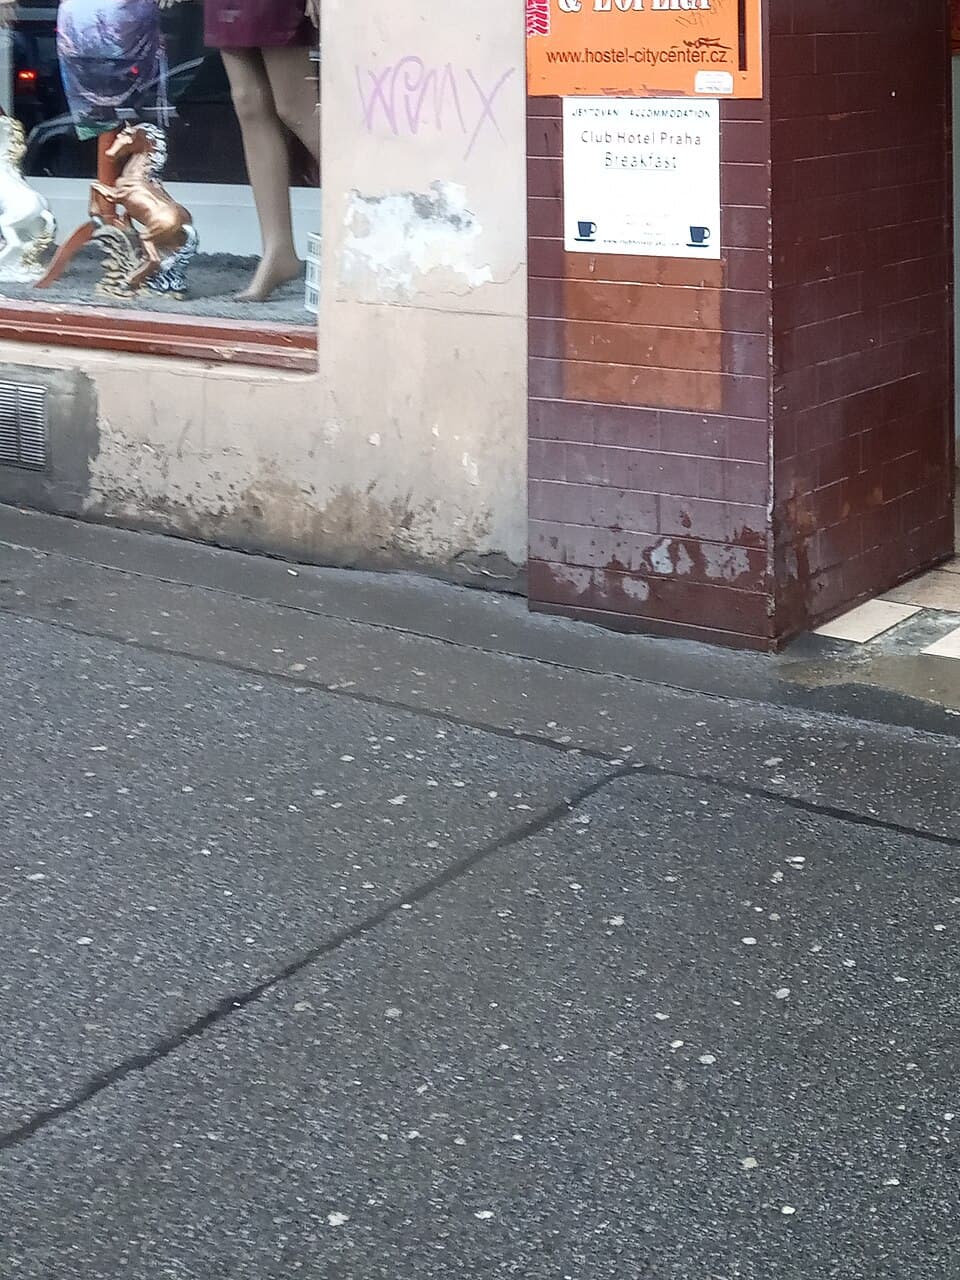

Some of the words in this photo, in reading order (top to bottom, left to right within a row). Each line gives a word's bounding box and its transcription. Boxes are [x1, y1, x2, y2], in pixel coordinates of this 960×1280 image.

[546, 47, 728, 66] www.hostel-citycenter.cz
[581, 130, 612, 143] Club
[617, 131, 655, 144] Hotel
[660, 132, 701, 145] Praha
[605, 151, 677, 168] Breakfast
